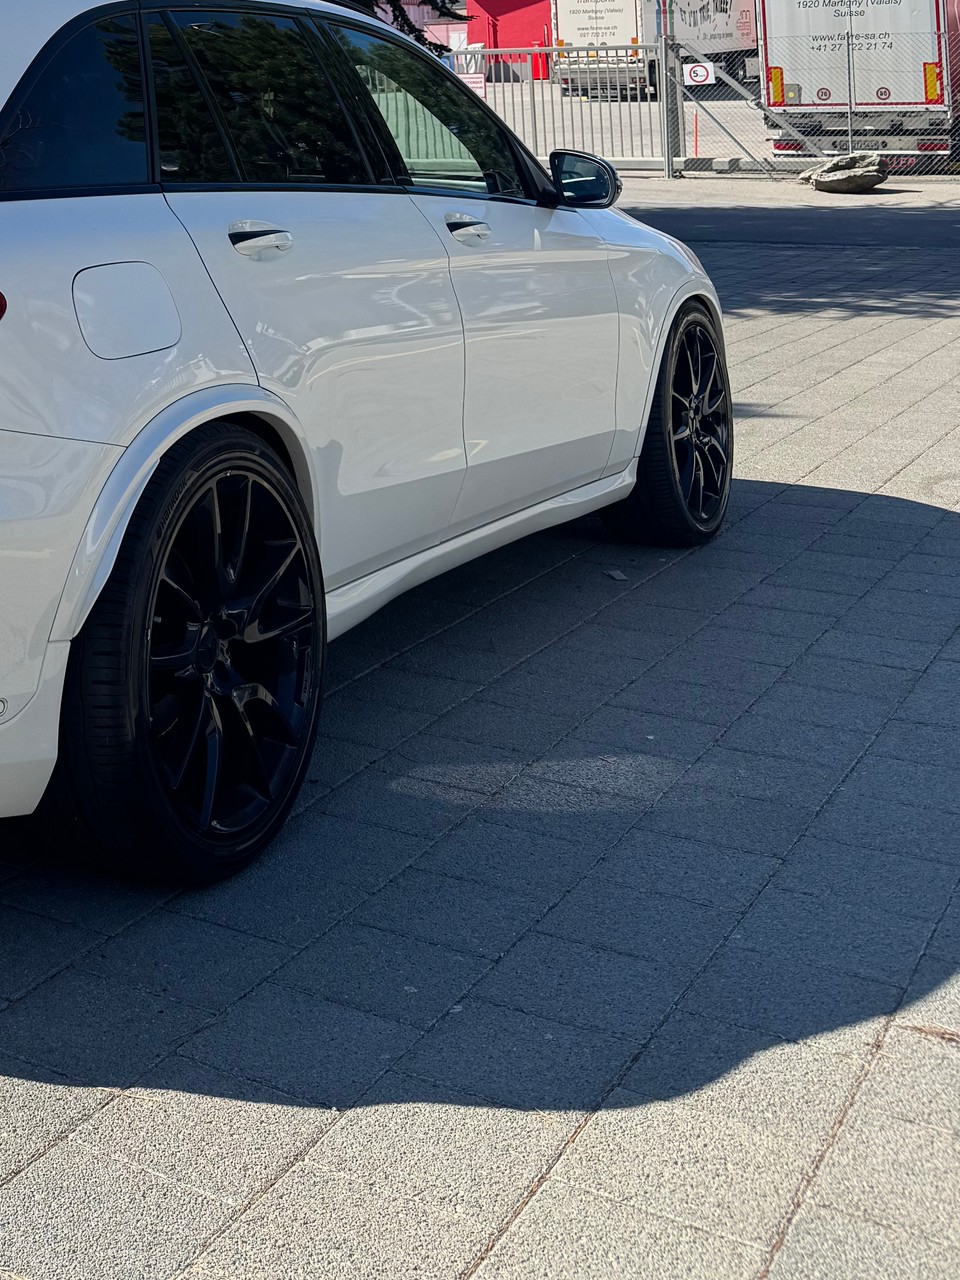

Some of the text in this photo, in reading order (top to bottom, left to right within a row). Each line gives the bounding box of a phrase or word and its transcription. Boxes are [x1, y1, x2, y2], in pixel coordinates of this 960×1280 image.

[796, 0, 820, 9] 1920
[821, 0, 863, 9] Martigny
[833, 9, 866, 18] Suisse
[810, 41, 893, 52] +41 27 22 21 74
[692, 69, 699, 78] 5
